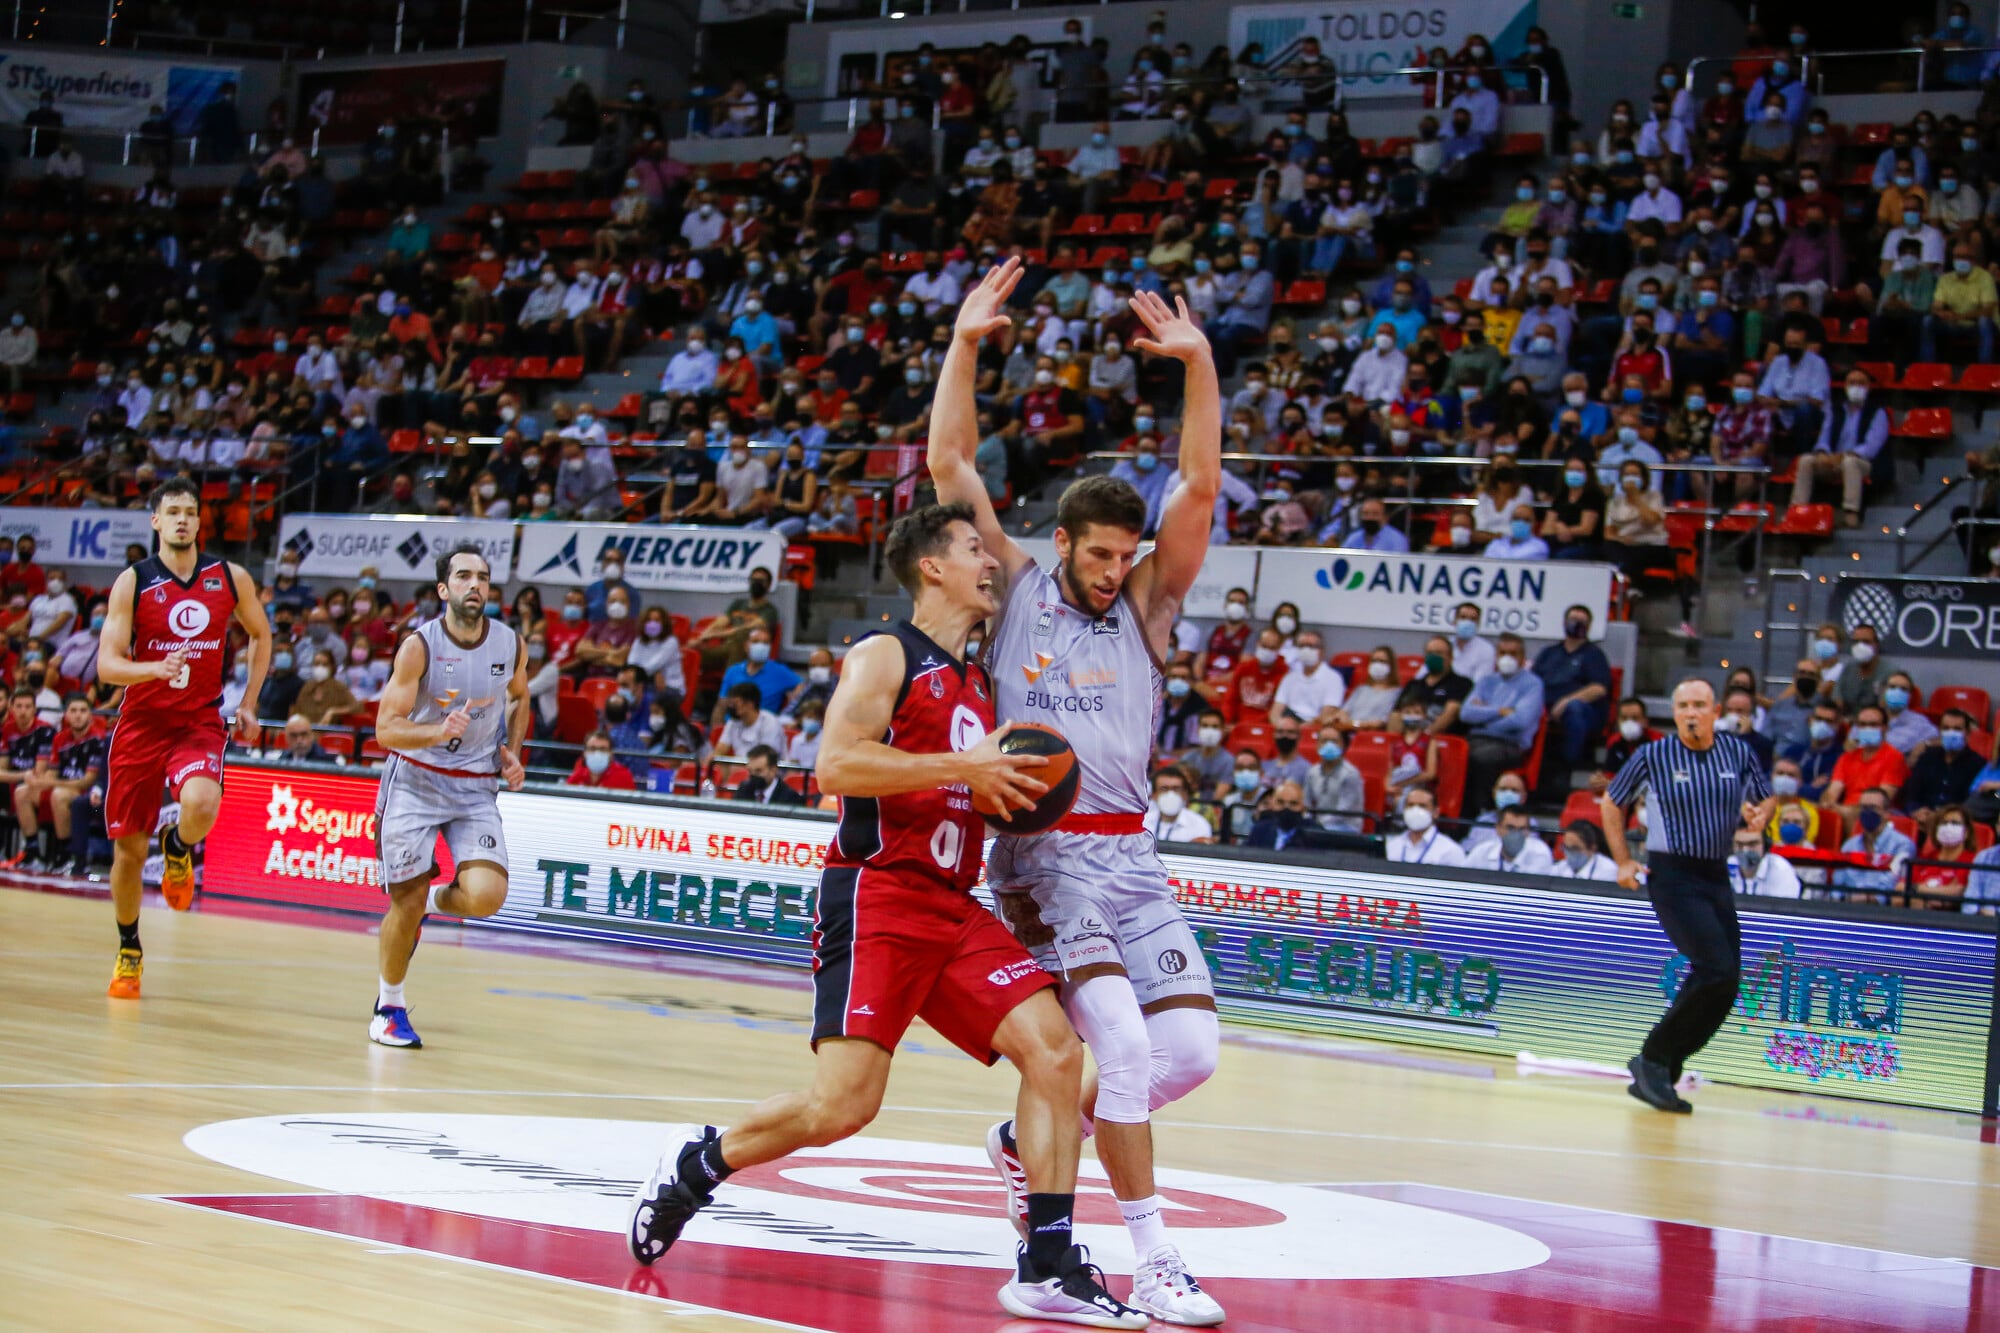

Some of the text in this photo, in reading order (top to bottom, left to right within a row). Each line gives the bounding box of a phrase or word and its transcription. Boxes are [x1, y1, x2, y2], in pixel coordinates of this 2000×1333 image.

[1318, 9, 1447, 42] TOLDOS
[7, 64, 153, 97] STSuperficies
[317, 532, 392, 557] SUGRAF
[594, 535, 763, 570] MERCURY
[1368, 561, 1546, 601] ANAGAN
[1903, 584, 1963, 600] GRUPO
[1410, 603, 1540, 631] SEGROS
[1025, 690, 1104, 713] BURGOS
[607, 824, 692, 854] DIVINA
[706, 833, 826, 869] SEGUROS
[1315, 892, 1421, 931] LANZA
[537, 859, 590, 911] TE
[1244, 934, 1500, 1013] SEGURO
[1068, 945, 1109, 959] GIVOVA
[1145, 974, 1207, 991] GRUPO HEREDA
